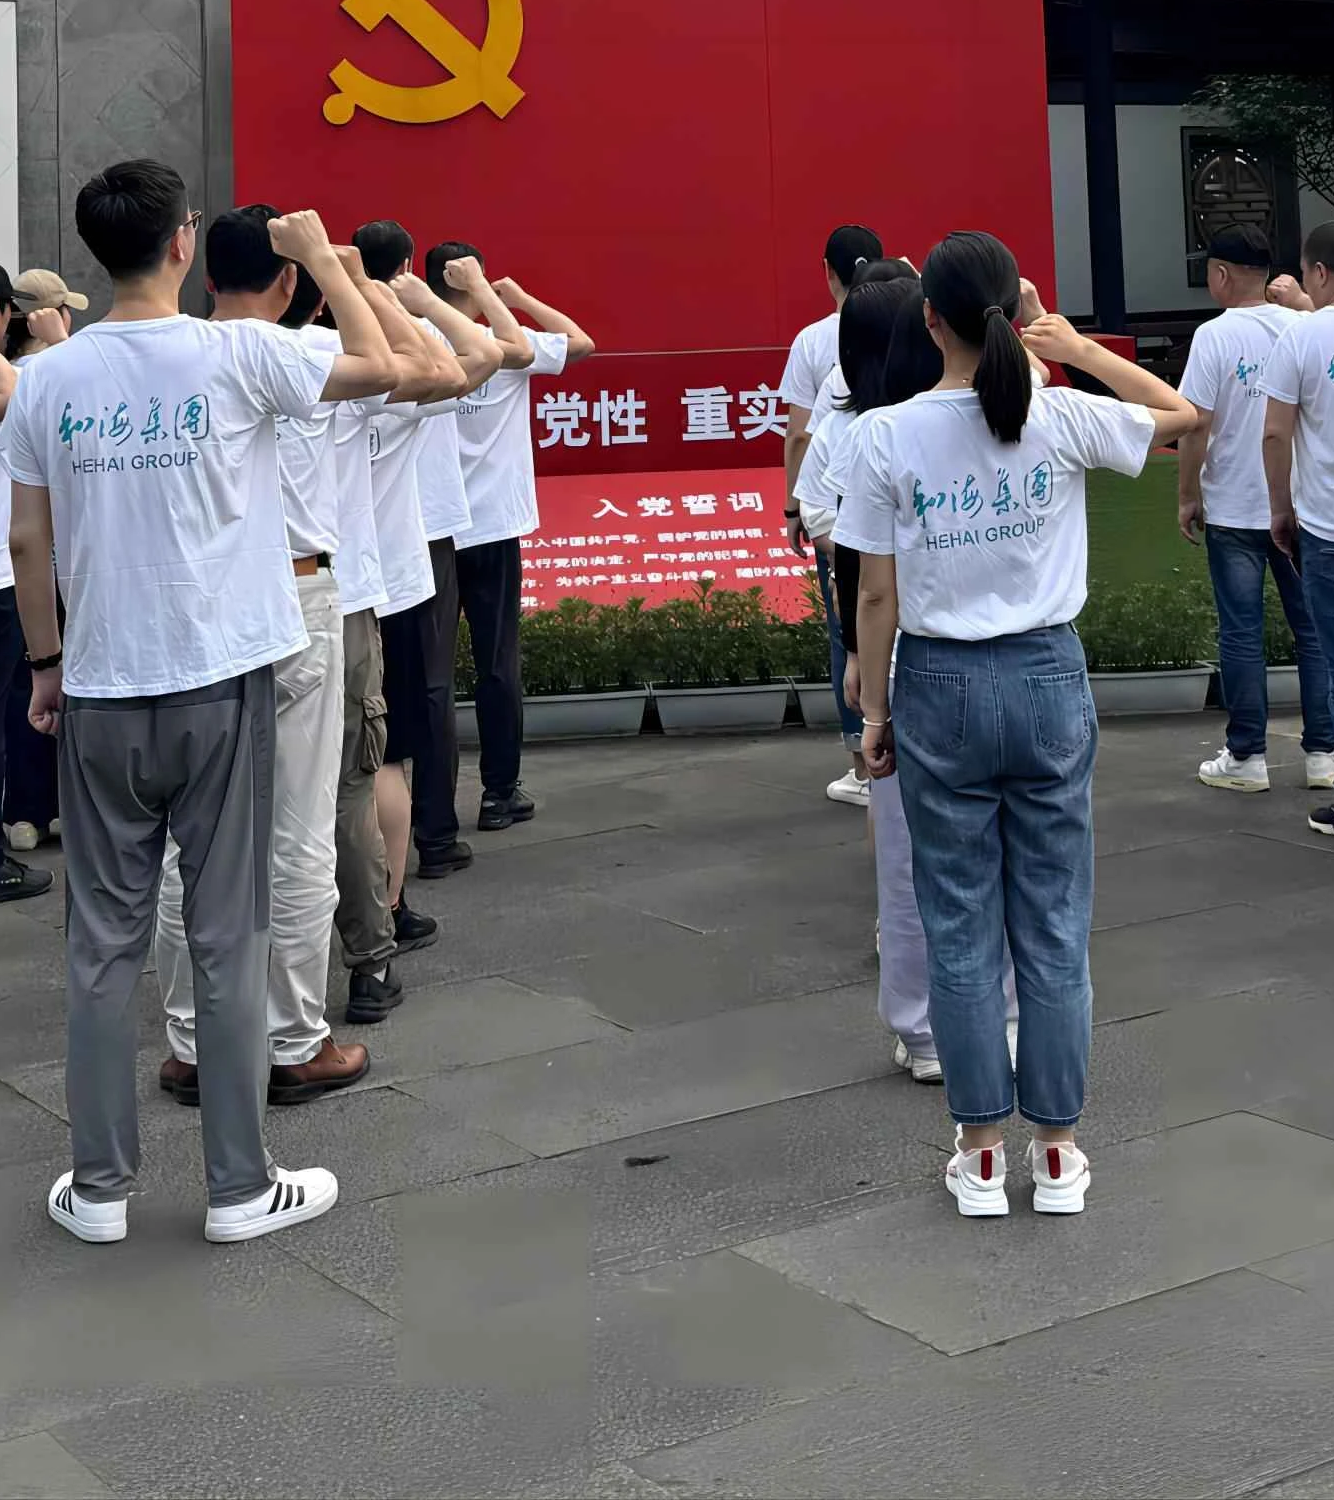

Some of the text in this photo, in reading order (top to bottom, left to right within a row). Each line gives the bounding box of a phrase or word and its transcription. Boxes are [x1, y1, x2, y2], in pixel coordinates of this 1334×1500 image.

[535, 388, 649, 449] 党性
[71, 451, 200, 475] HEHAI GROUP
[591, 491, 765, 520] 入党誓词
[925, 516, 1046, 551] HEHAI GROUP
